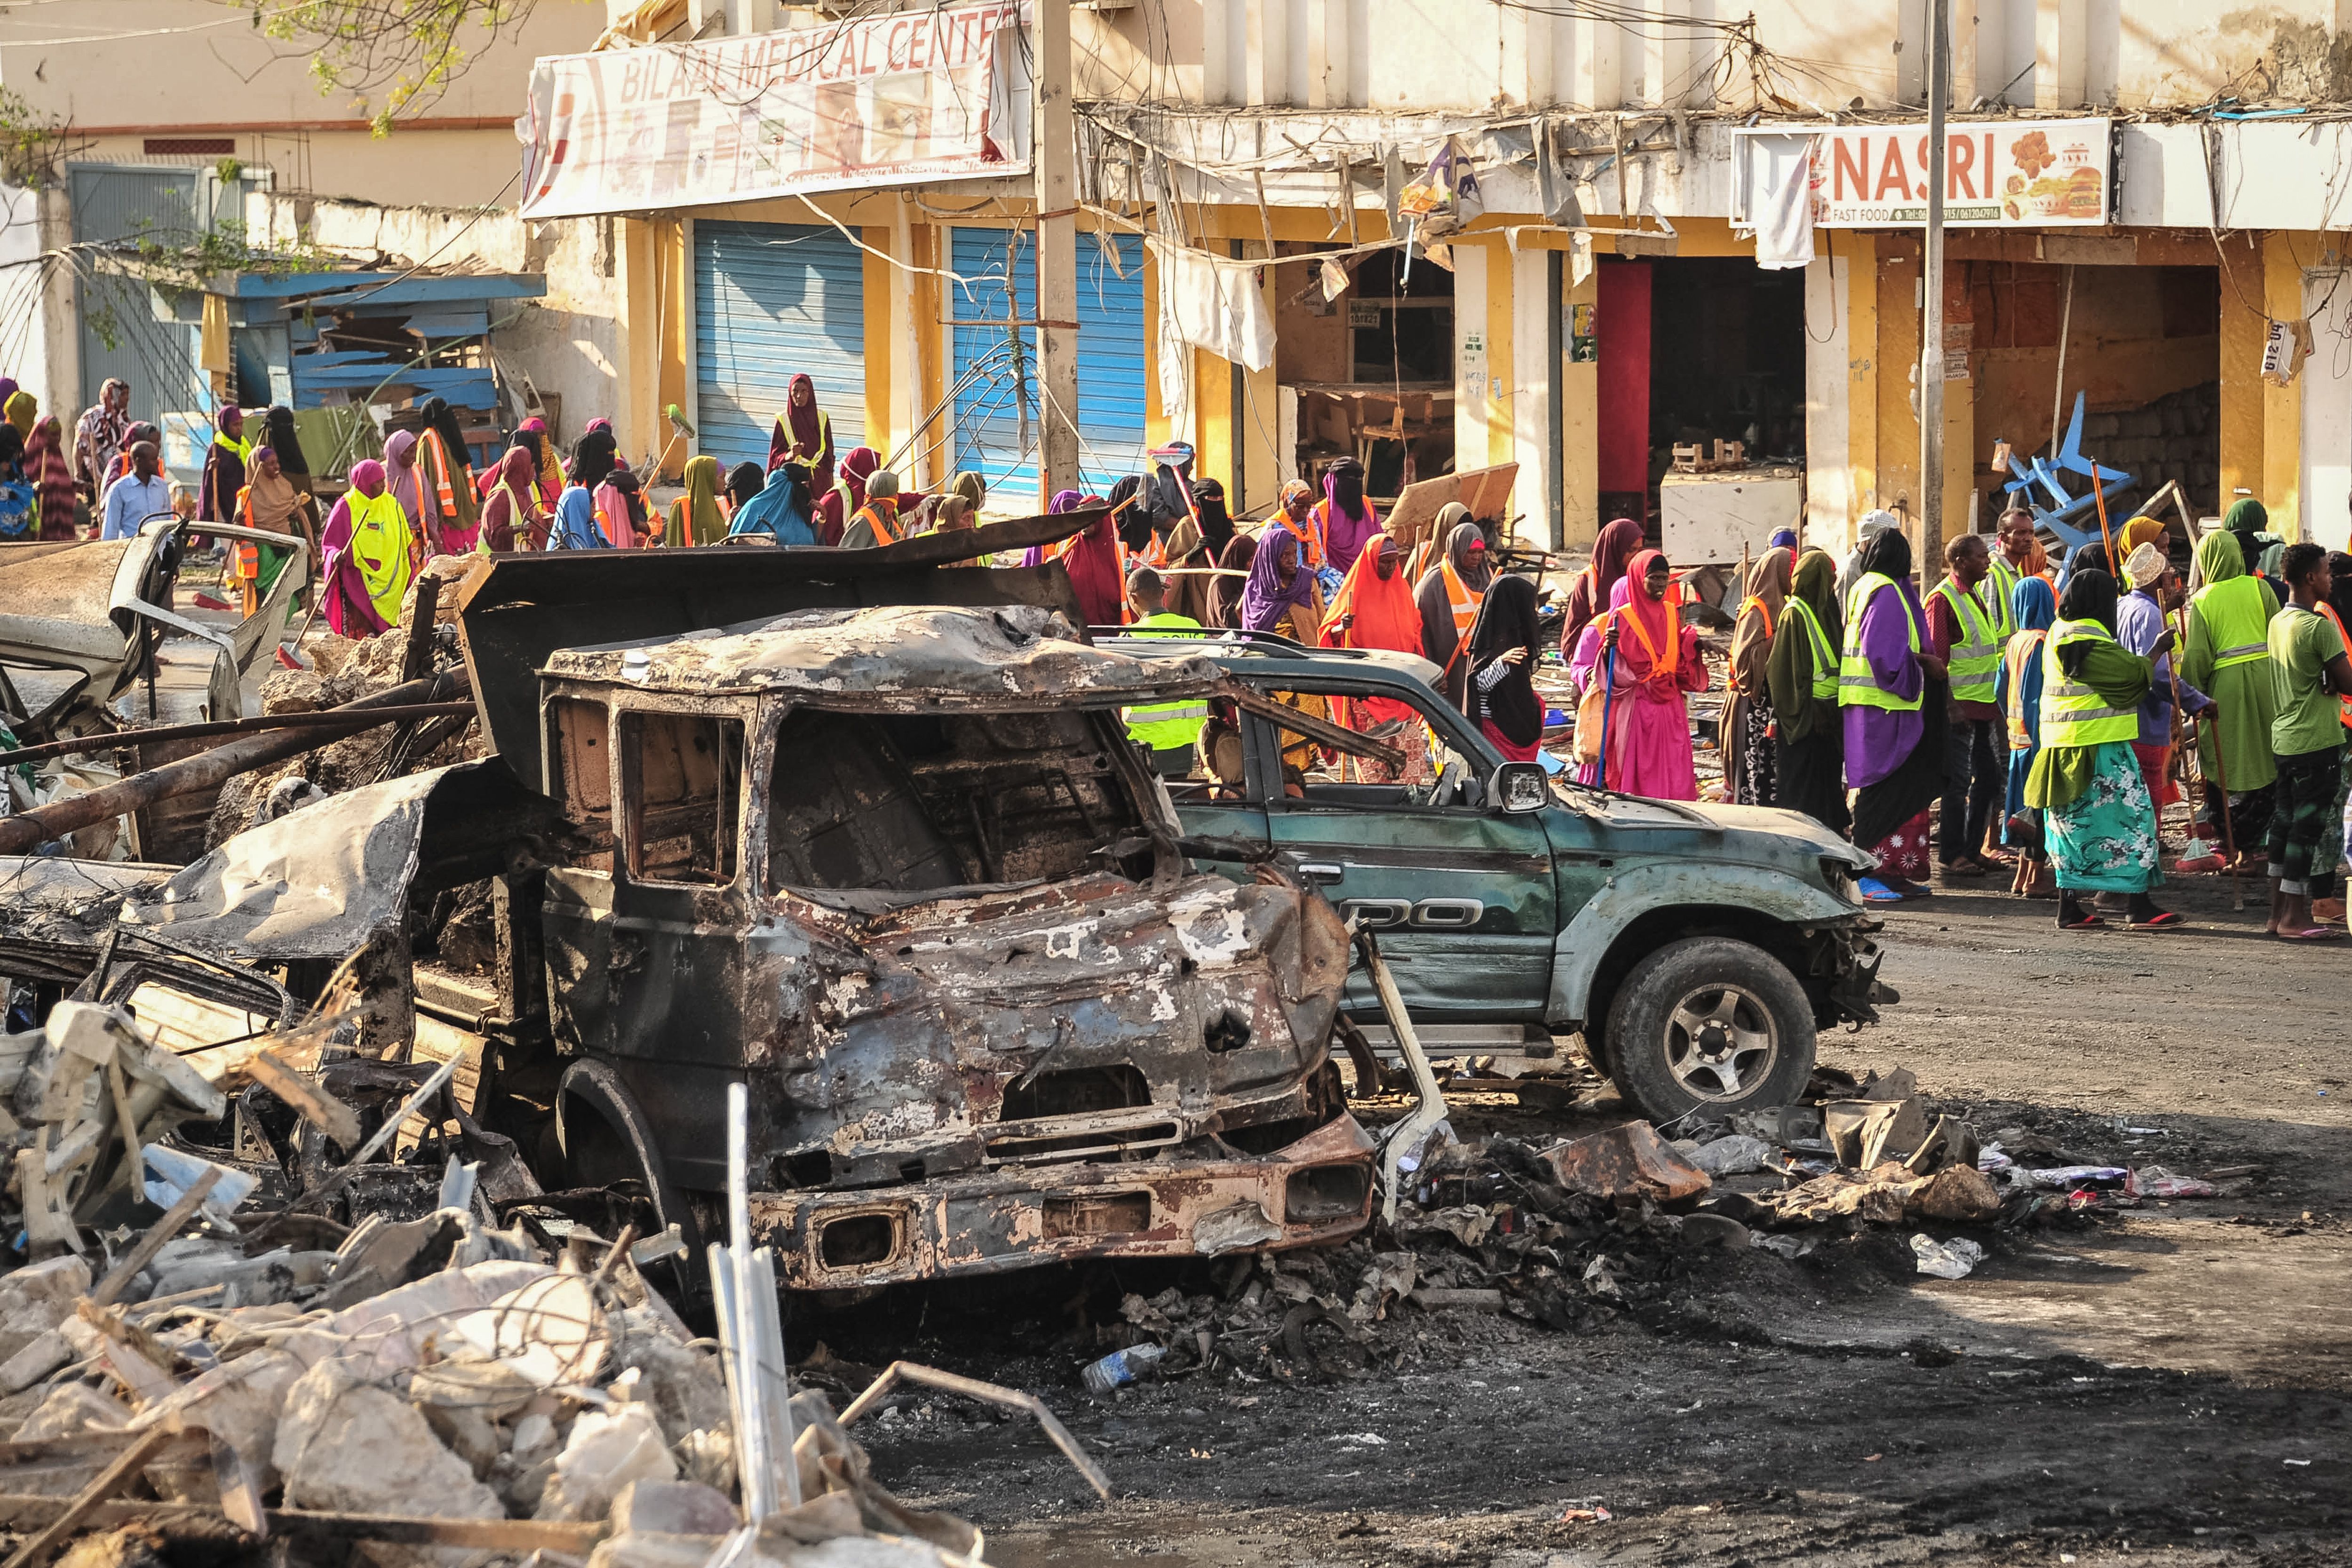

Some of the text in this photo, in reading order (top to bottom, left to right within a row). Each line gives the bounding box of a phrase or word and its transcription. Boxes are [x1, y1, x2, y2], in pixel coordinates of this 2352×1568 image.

[620, 46, 726, 103] BILAAL
[737, 25, 877, 90] MEDICAL
[1833, 133, 1994, 201] NASRI
[1834, 209, 1856, 222] FAST
[1860, 208, 1889, 221] FOOD
